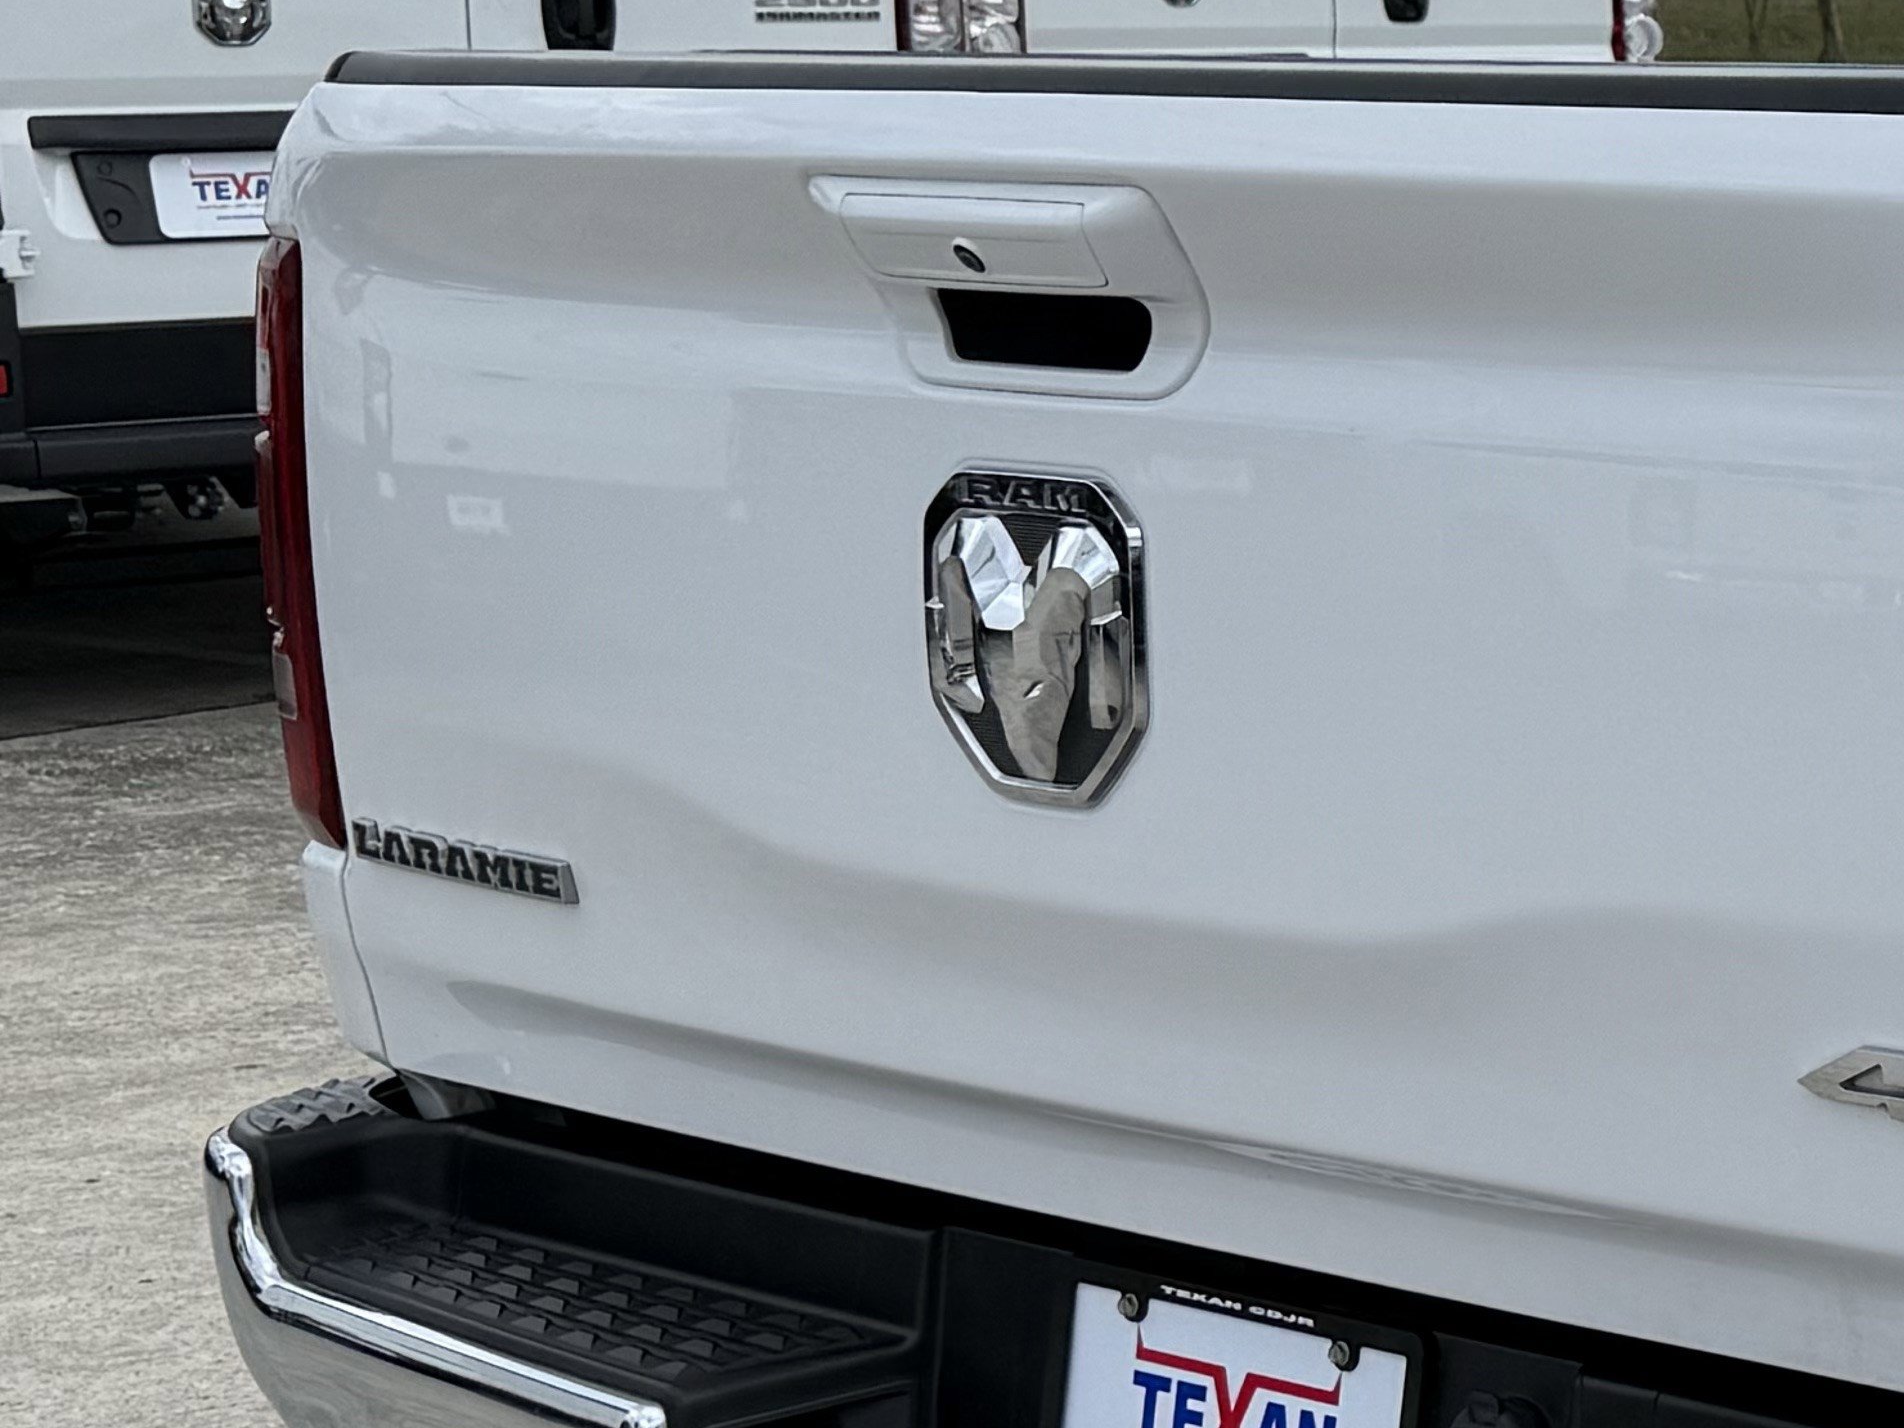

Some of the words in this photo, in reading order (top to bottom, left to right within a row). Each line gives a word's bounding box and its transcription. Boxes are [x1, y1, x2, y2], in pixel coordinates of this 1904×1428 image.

[961, 477, 1088, 514] RAM
[351, 818, 579, 904] LARAMIE
[1160, 1284, 1242, 1311] TEXAN
[1249, 1305, 1315, 1328] CDJR
